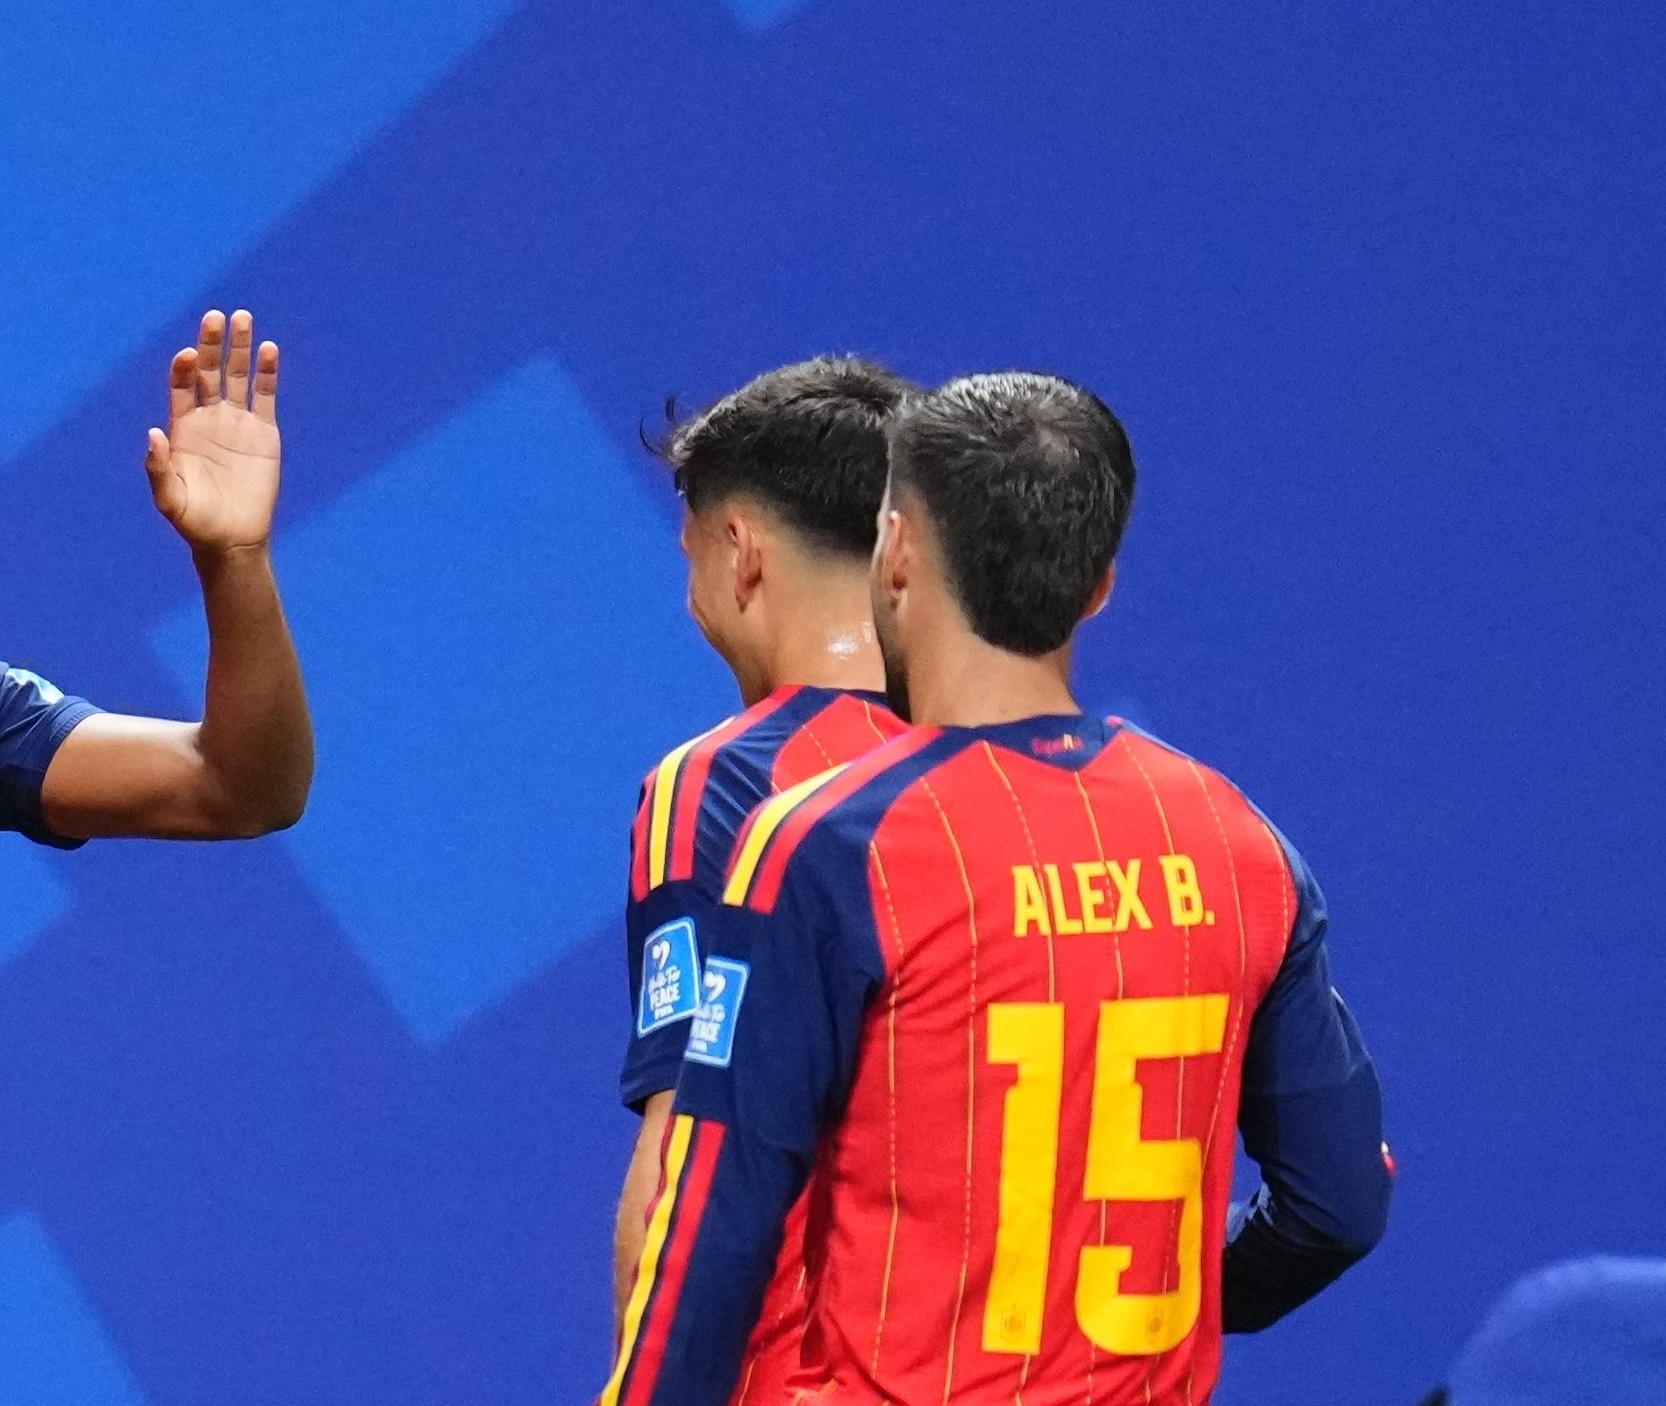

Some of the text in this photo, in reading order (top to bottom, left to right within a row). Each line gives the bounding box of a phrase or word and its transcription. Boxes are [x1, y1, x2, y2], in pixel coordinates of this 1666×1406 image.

[1013, 853, 1216, 937] ALEX B.
[981, 993, 1231, 1356] 15
